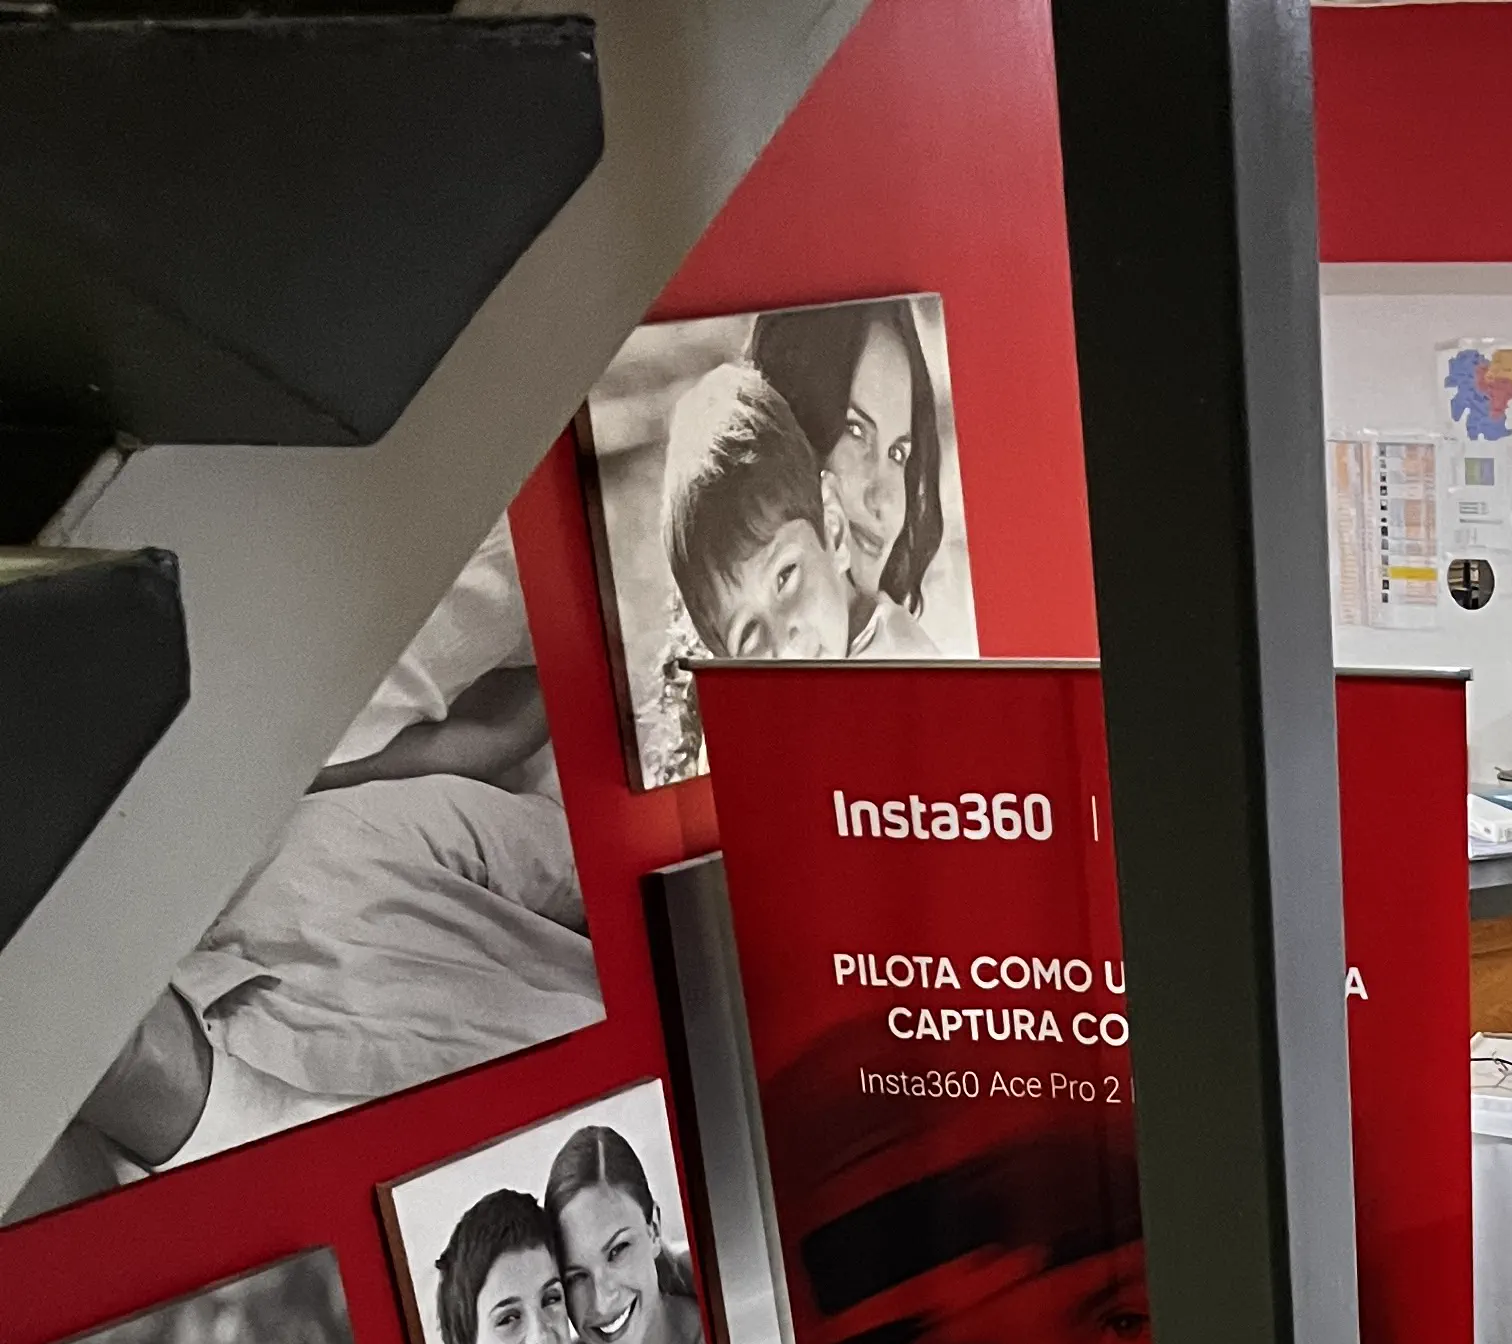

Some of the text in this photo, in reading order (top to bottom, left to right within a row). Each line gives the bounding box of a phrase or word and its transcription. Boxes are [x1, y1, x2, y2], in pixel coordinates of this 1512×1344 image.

[833, 790, 1053, 841] Insta360
[833, 953, 961, 989] PILOTA
[970, 956, 1093, 993] COMO
[888, 1007, 1064, 1043] CAPTURA
[860, 1067, 980, 1099] Insta360
[990, 1071, 1042, 1098] Ace
[1050, 1073, 1096, 1102] Pro
[1103, 1076, 1122, 1103] 2
